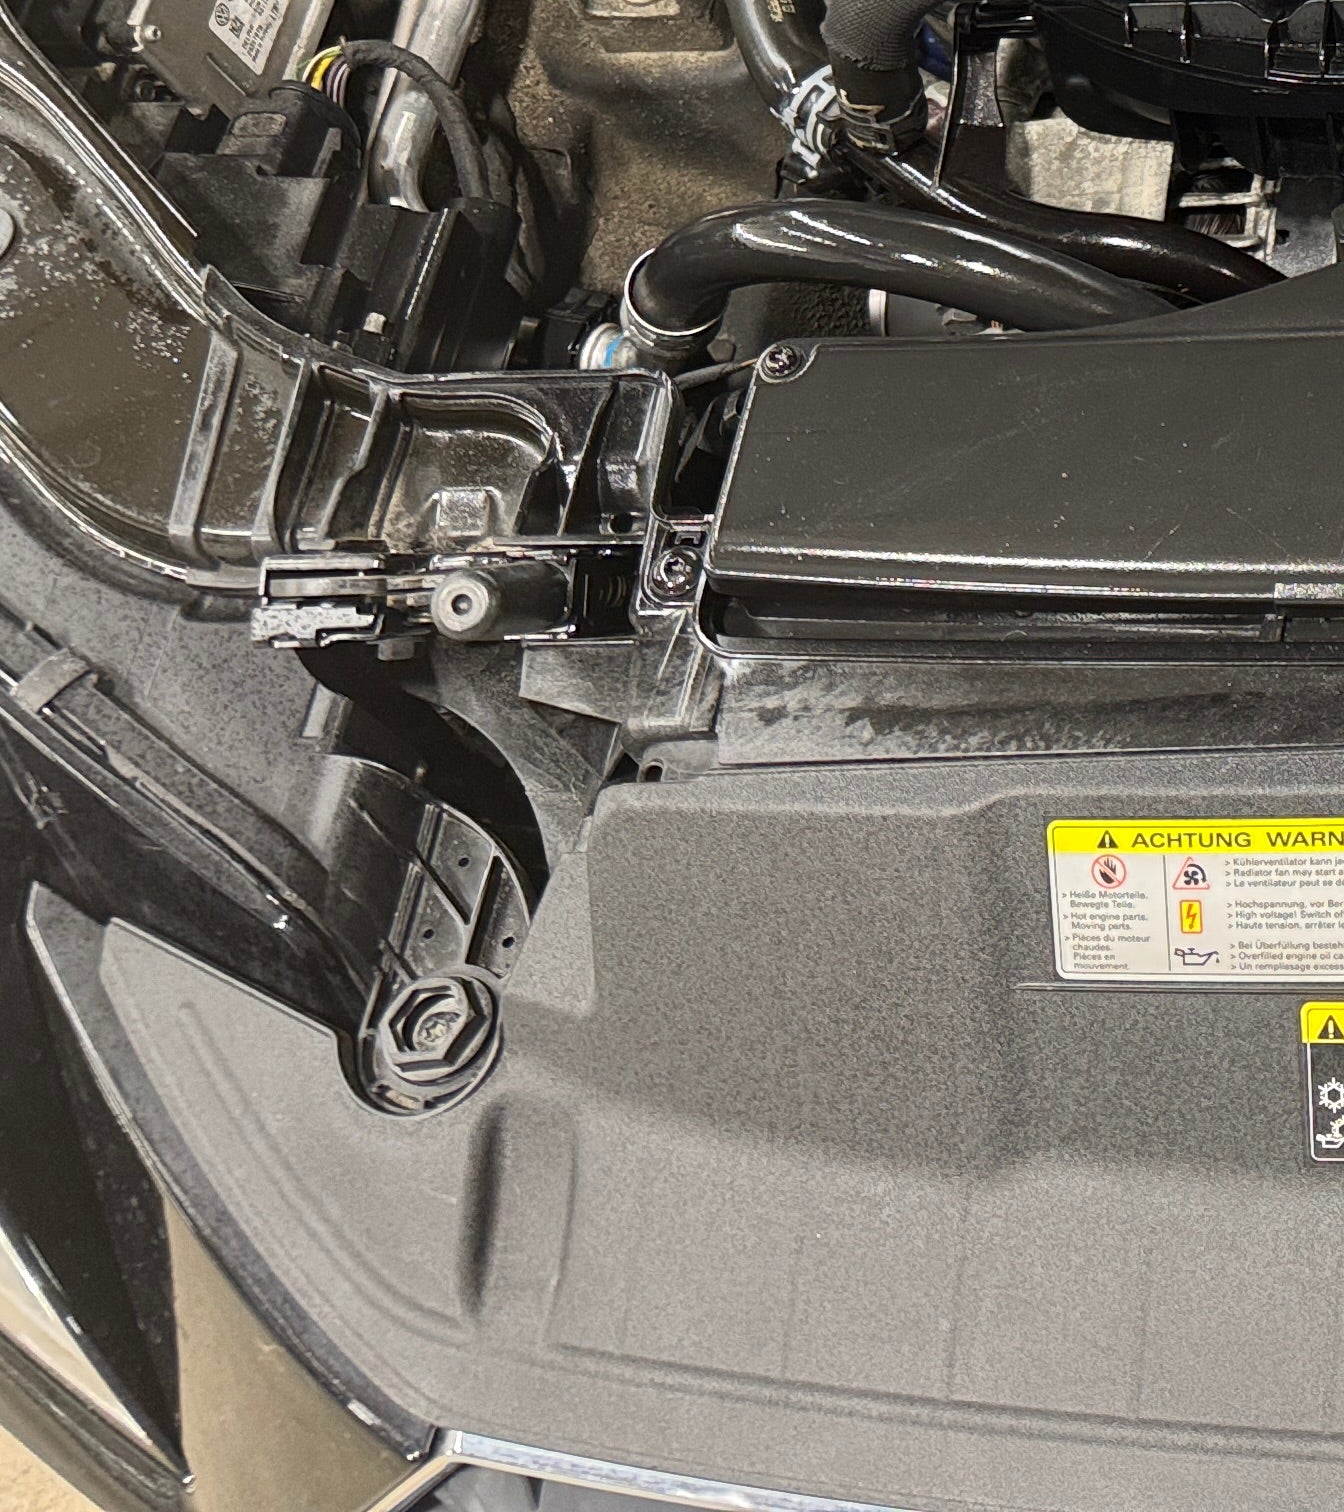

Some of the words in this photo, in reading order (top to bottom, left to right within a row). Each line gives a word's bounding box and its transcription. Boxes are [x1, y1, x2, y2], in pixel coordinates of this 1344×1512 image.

[1131, 832, 1252, 848] ACHTUNG
[1233, 857, 1307, 866] Kühlerventilator
[1309, 857, 1332, 865] kann
[1234, 869, 1272, 877] Radiator
[1275, 868, 1289, 876] fan
[1292, 869, 1313, 878] may
[1315, 868, 1336, 876] start
[1234, 879, 1244, 887] Le
[1247, 879, 1297, 887] ventilateur
[1300, 879, 1320, 889] peut
[1070, 912, 1087, 921] Hot
[1089, 913, 1120, 923] engine
[1122, 913, 1148, 923] parts.
[1236, 911, 1257, 920] High
[1300, 910, 1331, 919] Switch
[1071, 921, 1106, 931] Moving
[1108, 922, 1132, 931] parts.
[1236, 921, 1263, 929] Haute
[1305, 920, 1336, 929] arrêter
[1072, 934, 1101, 943] Pièces
[1102, 934, 1115, 943] du
[1118, 935, 1151, 943] moteur
[1072, 943, 1112, 952] chaudes.
[1238, 941, 1253, 949] Bei
[1256, 939, 1310, 952] Überfüllung
[1073, 952, 1102, 961] Pièces
[1104, 953, 1116, 961] en
[1238, 952, 1283, 960] Overfilled
[1285, 953, 1317, 962] engine
[1319, 952, 1331, 960] oil
[1239, 963, 1253, 971] Un
[1255, 962, 1311, 972] remplissage
